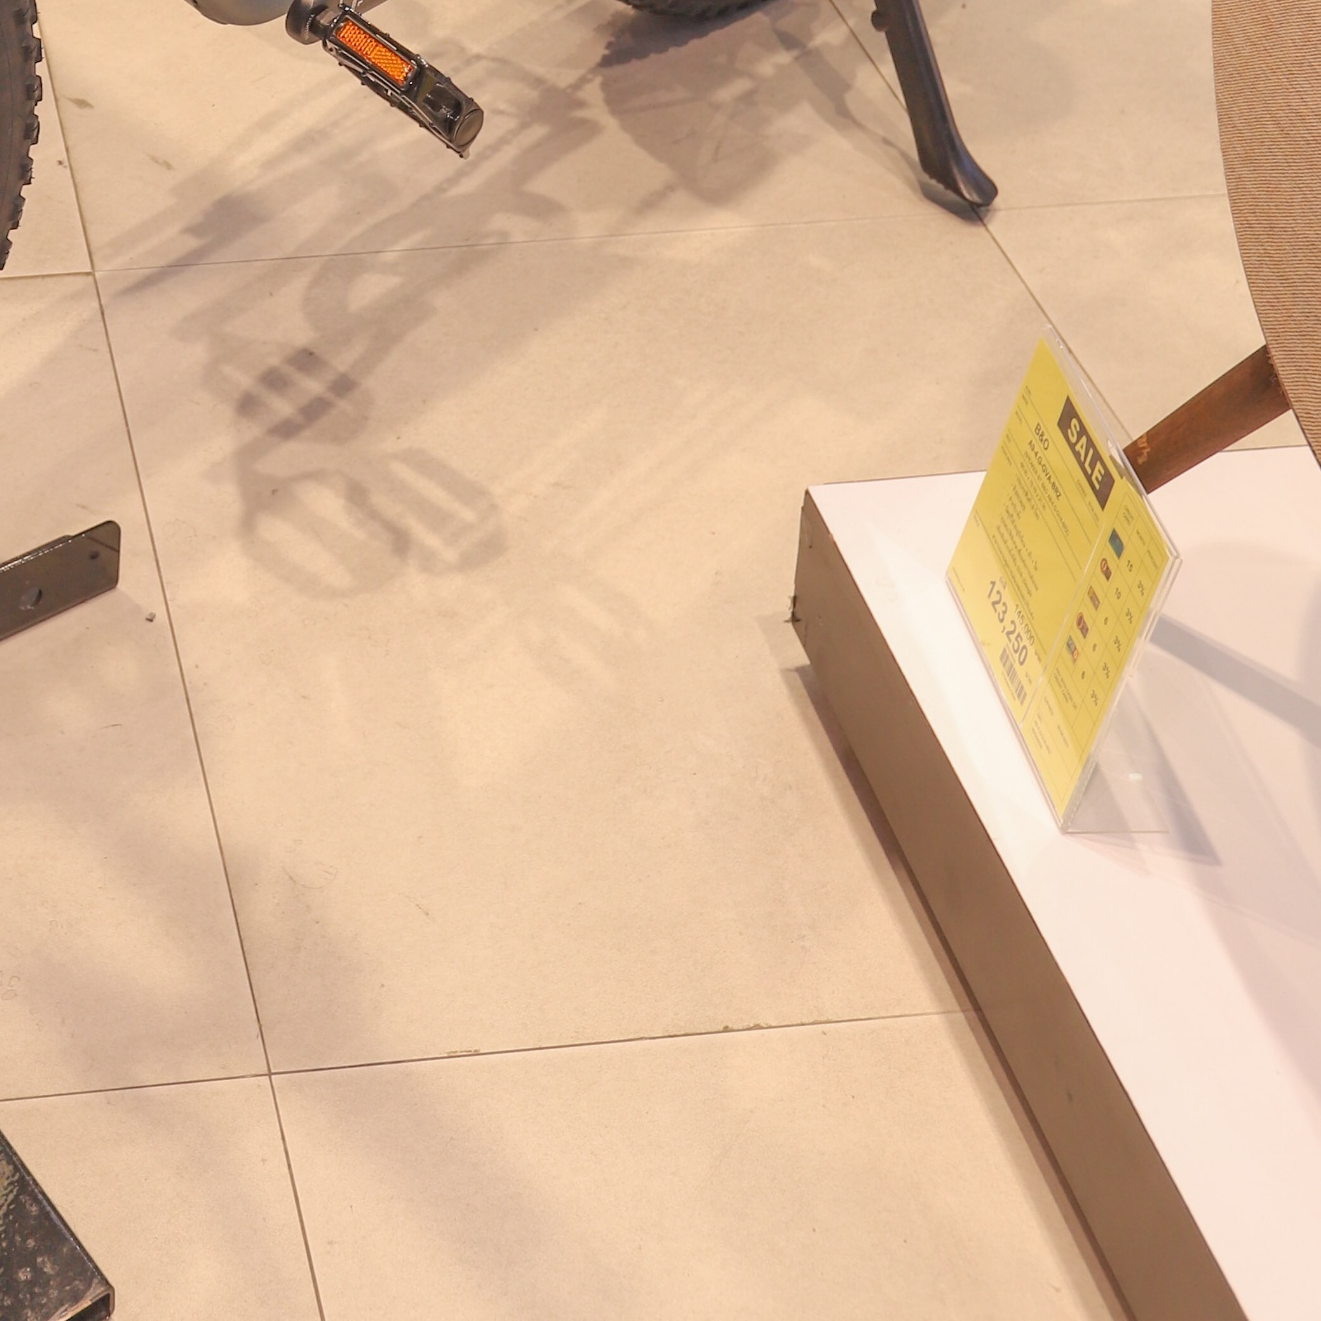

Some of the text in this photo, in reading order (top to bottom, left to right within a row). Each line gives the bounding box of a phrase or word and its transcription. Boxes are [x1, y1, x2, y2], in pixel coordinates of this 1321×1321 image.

[1033, 420, 1050, 453] B&O
[1065, 413, 1106, 492] SALE
[1125, 557, 1146, 597] 15 3%
[984, 575, 1029, 671] 123,250
[1012, 601, 1035, 649] 145,000
[1113, 585, 1134, 626] 10 3%
[1112, 633, 1122, 654] 3%
[1101, 660, 1110, 681] 3%
[1090, 687, 1099, 707] 3%
